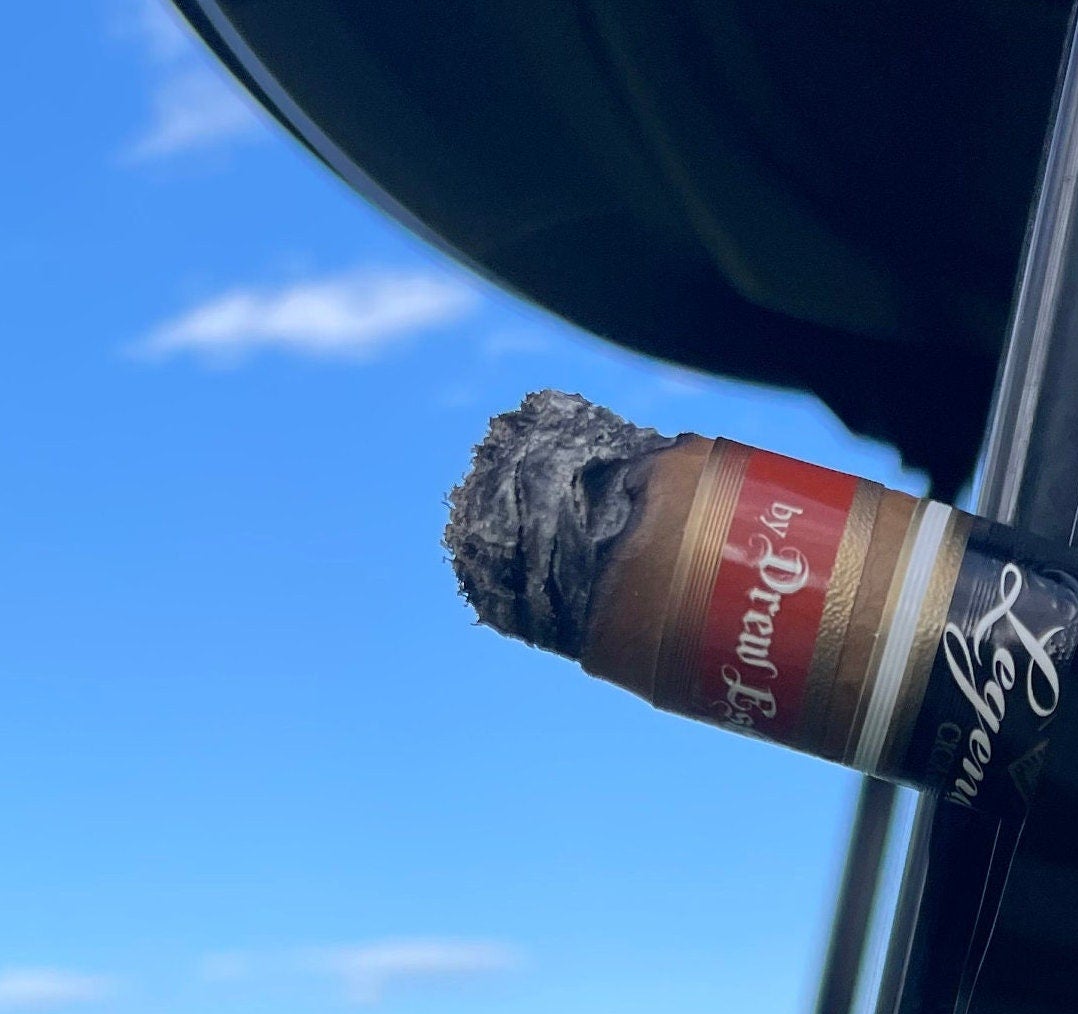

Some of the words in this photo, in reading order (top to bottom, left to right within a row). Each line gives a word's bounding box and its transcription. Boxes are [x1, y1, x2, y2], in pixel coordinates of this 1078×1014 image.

[760, 502, 803, 538] by
[737, 533, 809, 679] Drew
[712, 664, 776, 727] Es
